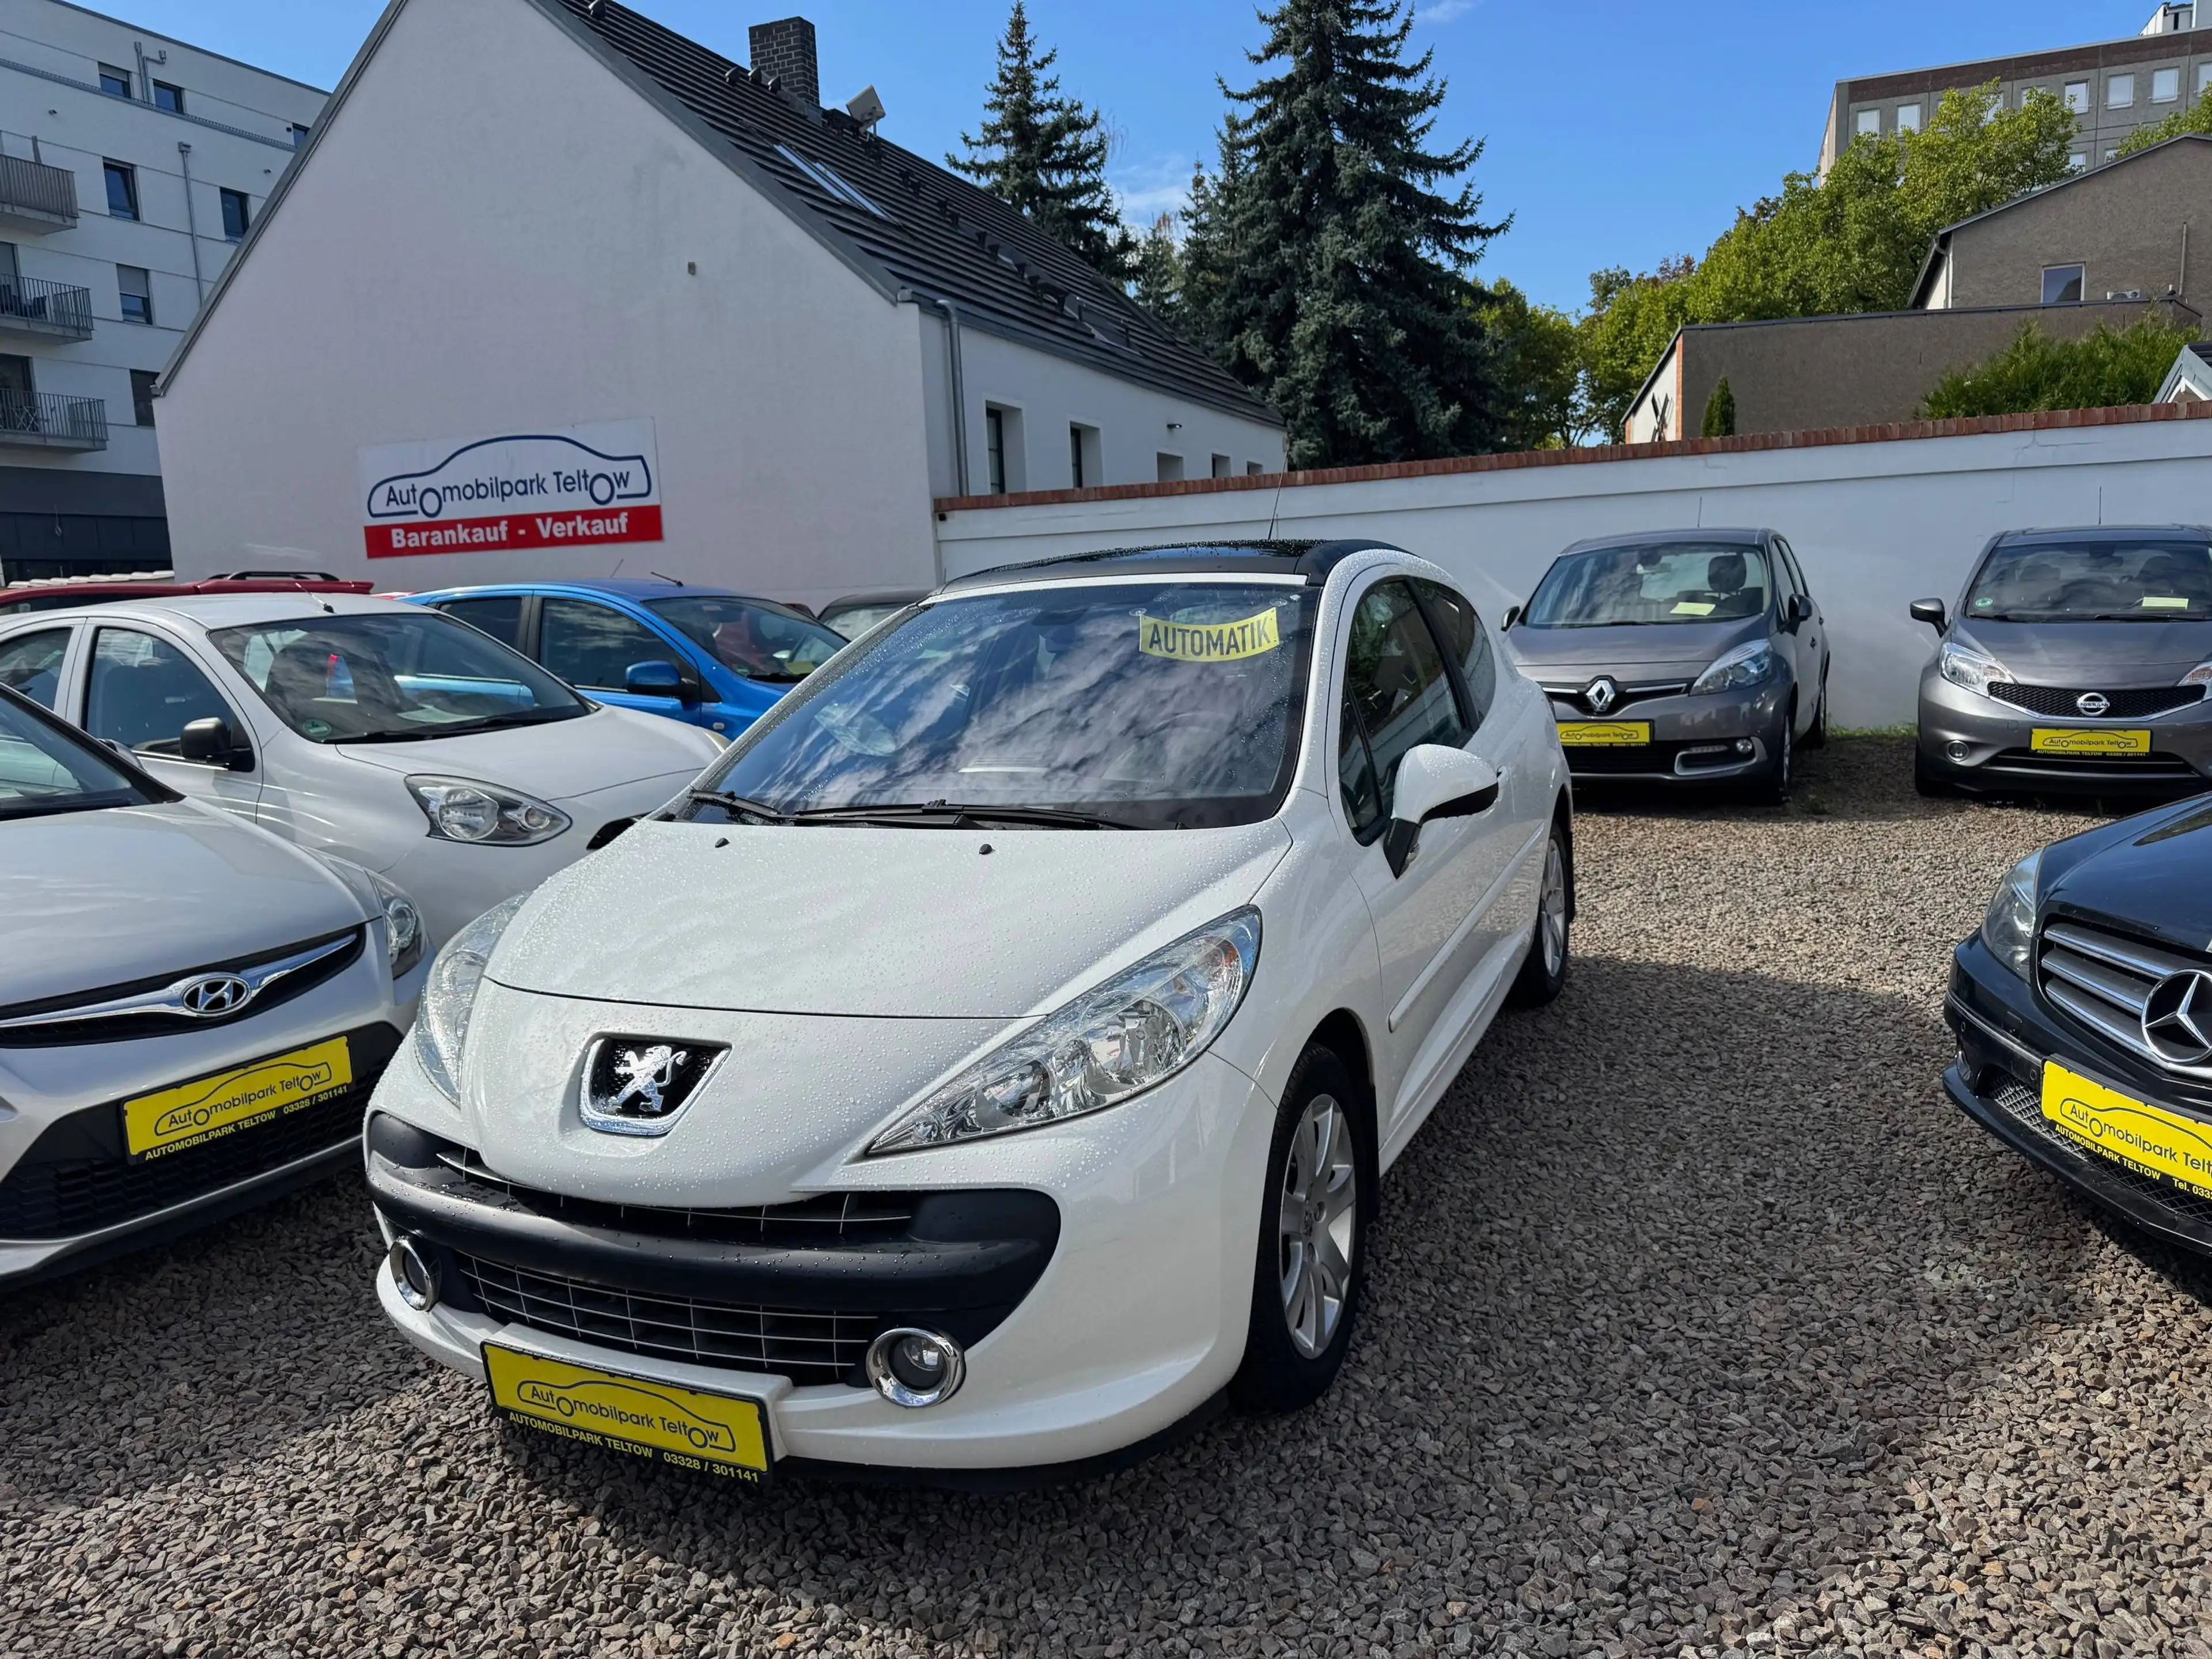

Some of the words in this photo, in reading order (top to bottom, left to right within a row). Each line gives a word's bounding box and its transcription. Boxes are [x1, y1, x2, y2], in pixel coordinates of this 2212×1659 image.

[391, 520, 508, 548] Barankauf
[536, 512, 628, 539] Verkauf
[1149, 616, 1272, 656] AUTOMATIK
[145, 1123, 236, 1161] AUTOMOBILPARK
[237, 1110, 276, 1131] TELTOW
[283, 1099, 310, 1115] 03328
[317, 1086, 347, 1102] 301141
[2055, 1123, 2120, 1164] AUTOMOBILPARK
[2122, 1157, 2161, 1180] TELTOW
[2172, 1177, 2190, 1192] Tel.
[2192, 1185, 2212, 1200] 033
[509, 1411, 603, 1446] AUTOMOBILPARK
[605, 1437, 653, 1459] TELTOW
[663, 1452, 701, 1469] 03328
[704, 1463, 709, 1472] /
[713, 1463, 759, 1483] 301141
